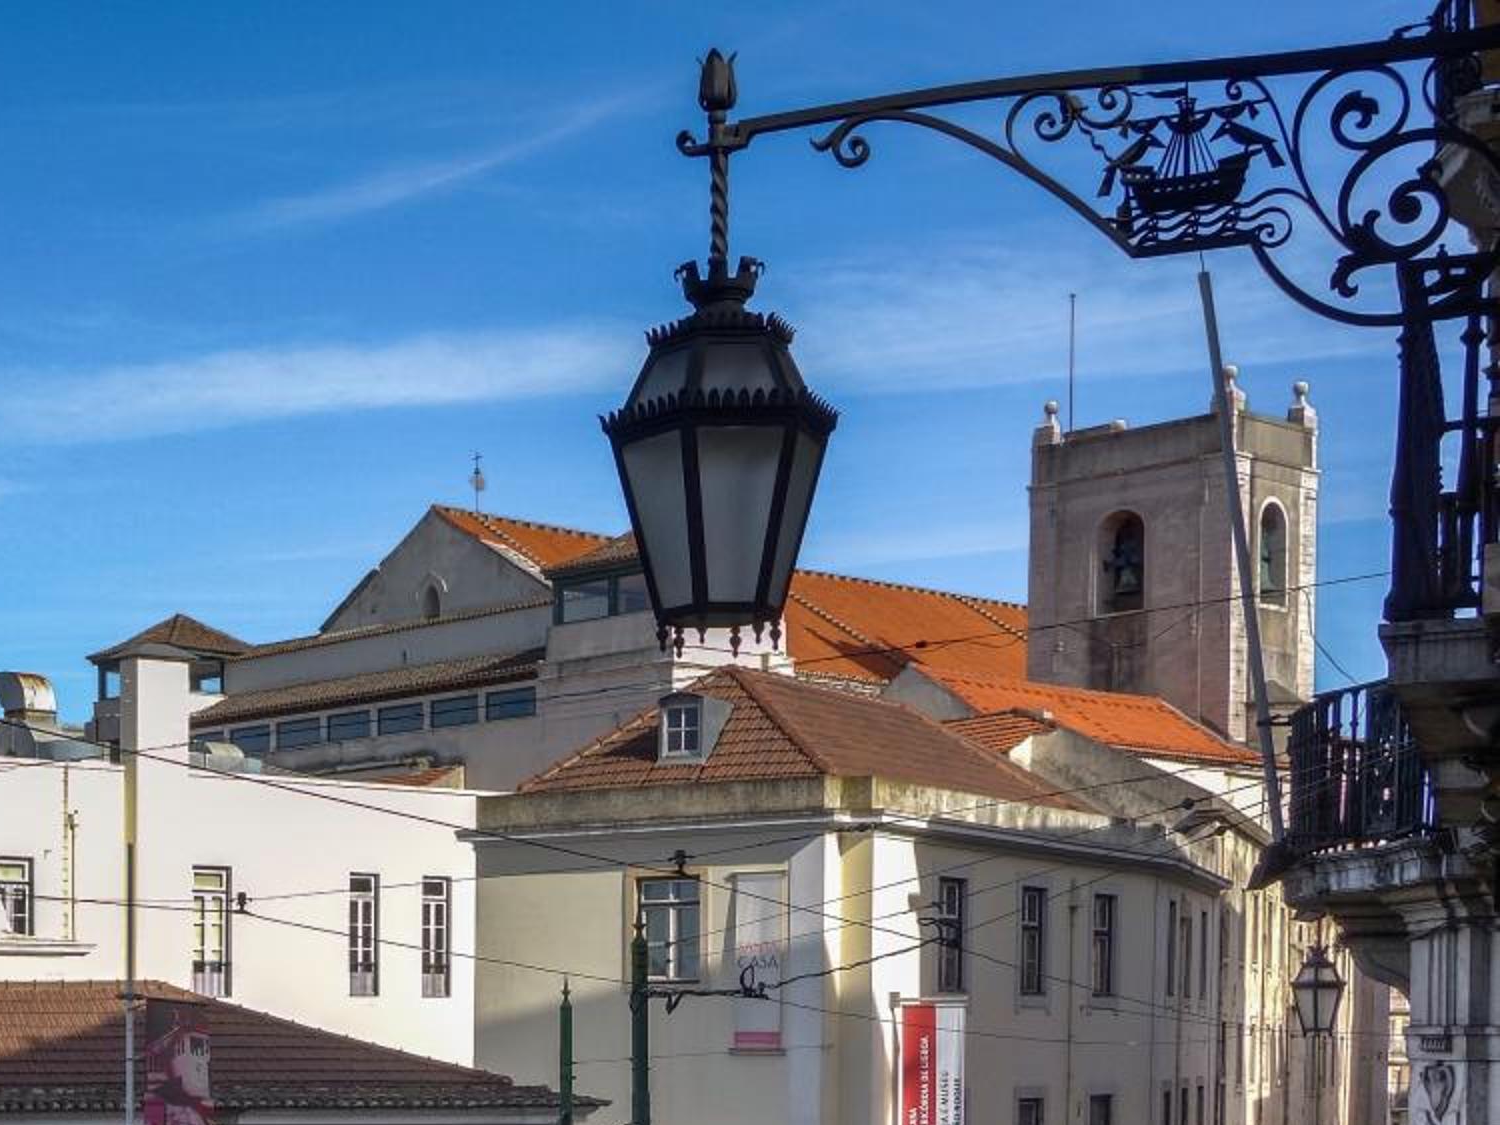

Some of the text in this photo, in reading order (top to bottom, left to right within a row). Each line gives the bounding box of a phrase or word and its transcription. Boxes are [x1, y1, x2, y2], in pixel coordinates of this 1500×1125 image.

[919, 1035, 929, 1069] LISBOA
[919, 1070, 929, 1081] DE
[939, 1071, 949, 1105] MUSEU
